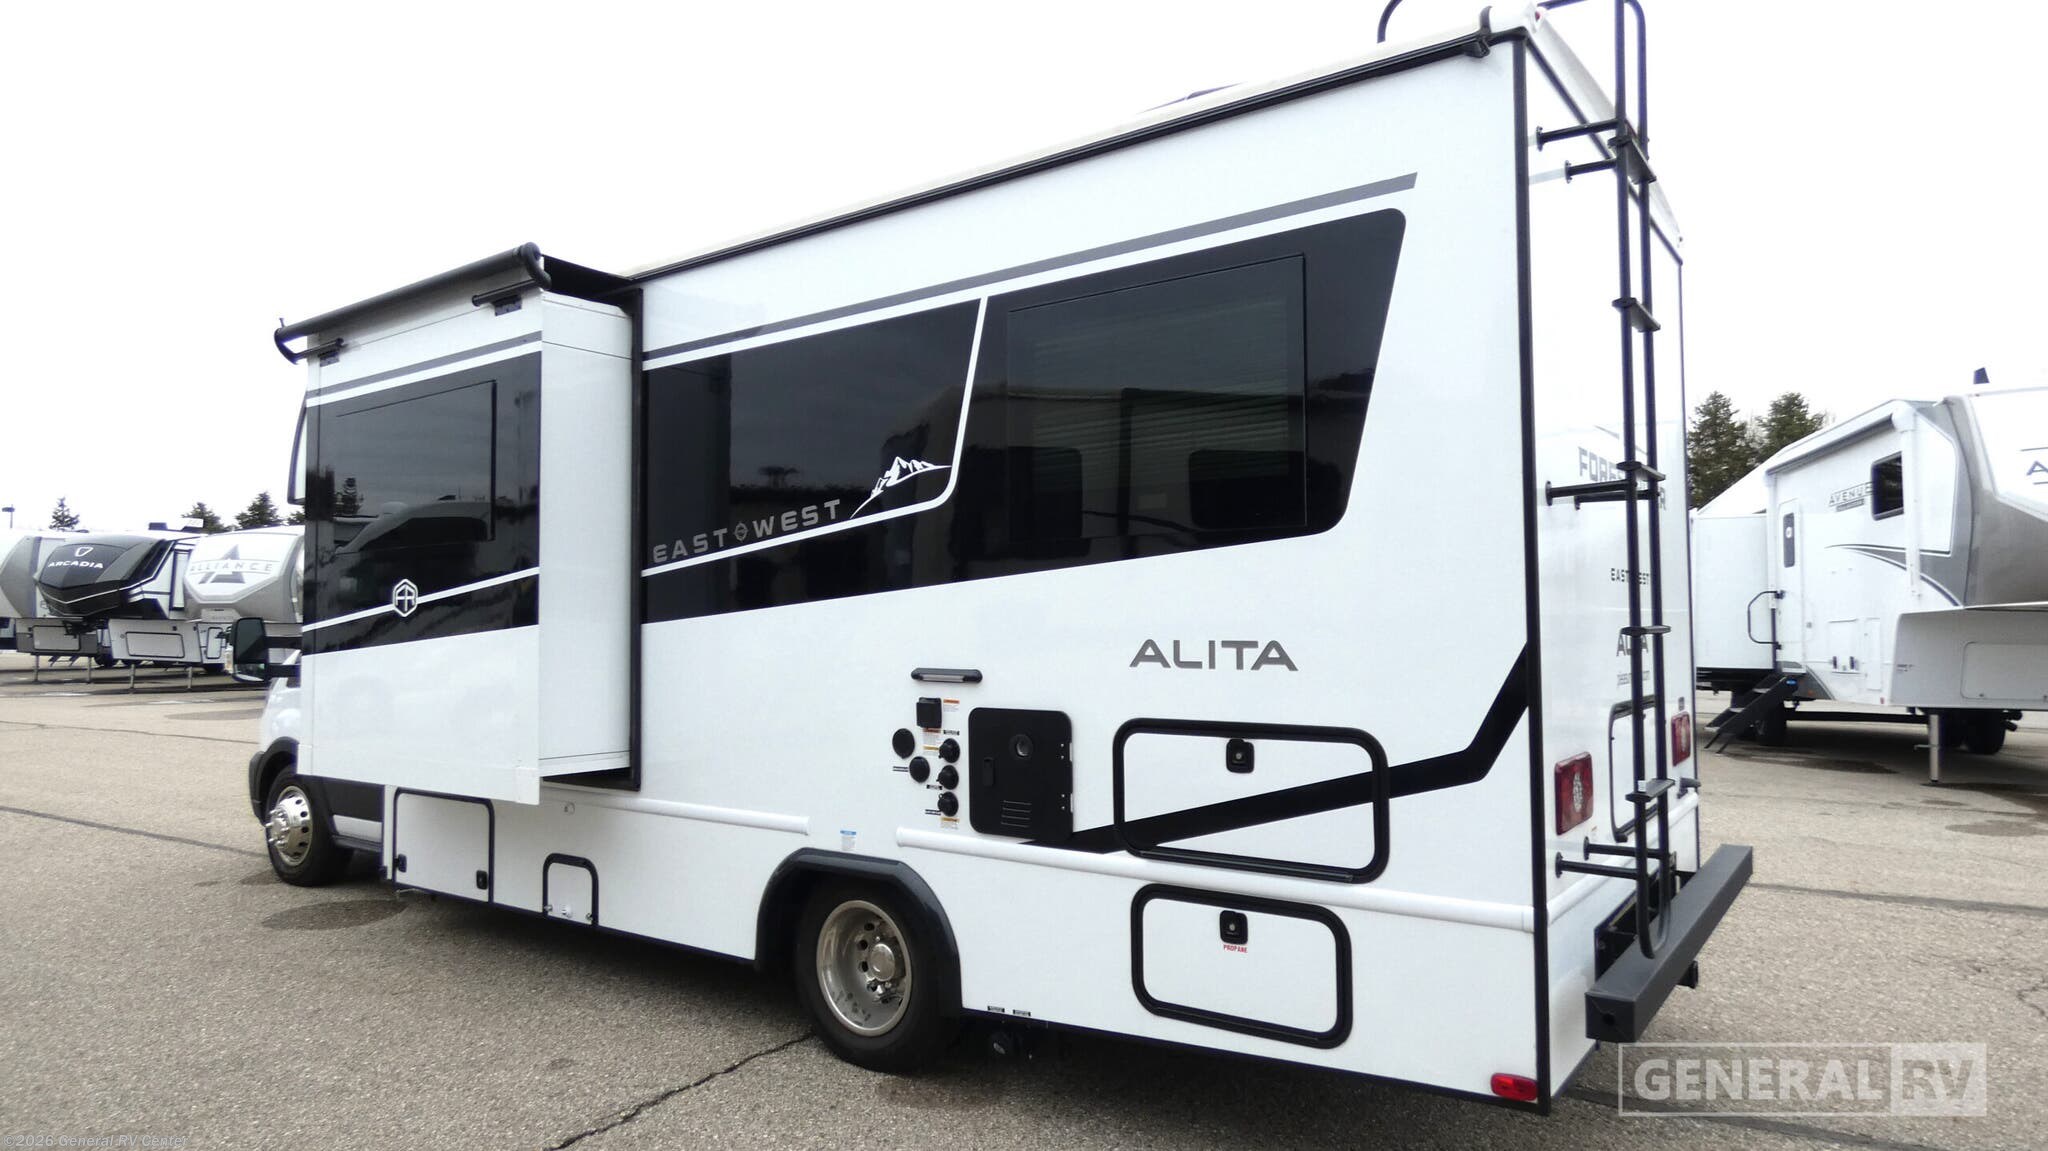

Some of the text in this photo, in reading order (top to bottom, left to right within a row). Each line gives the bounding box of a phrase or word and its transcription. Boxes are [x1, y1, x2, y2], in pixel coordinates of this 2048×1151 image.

[653, 499, 840, 563] EAST WEST
[48, 560, 103, 569] ARCADIA
[1129, 638, 1299, 672] ALITA
